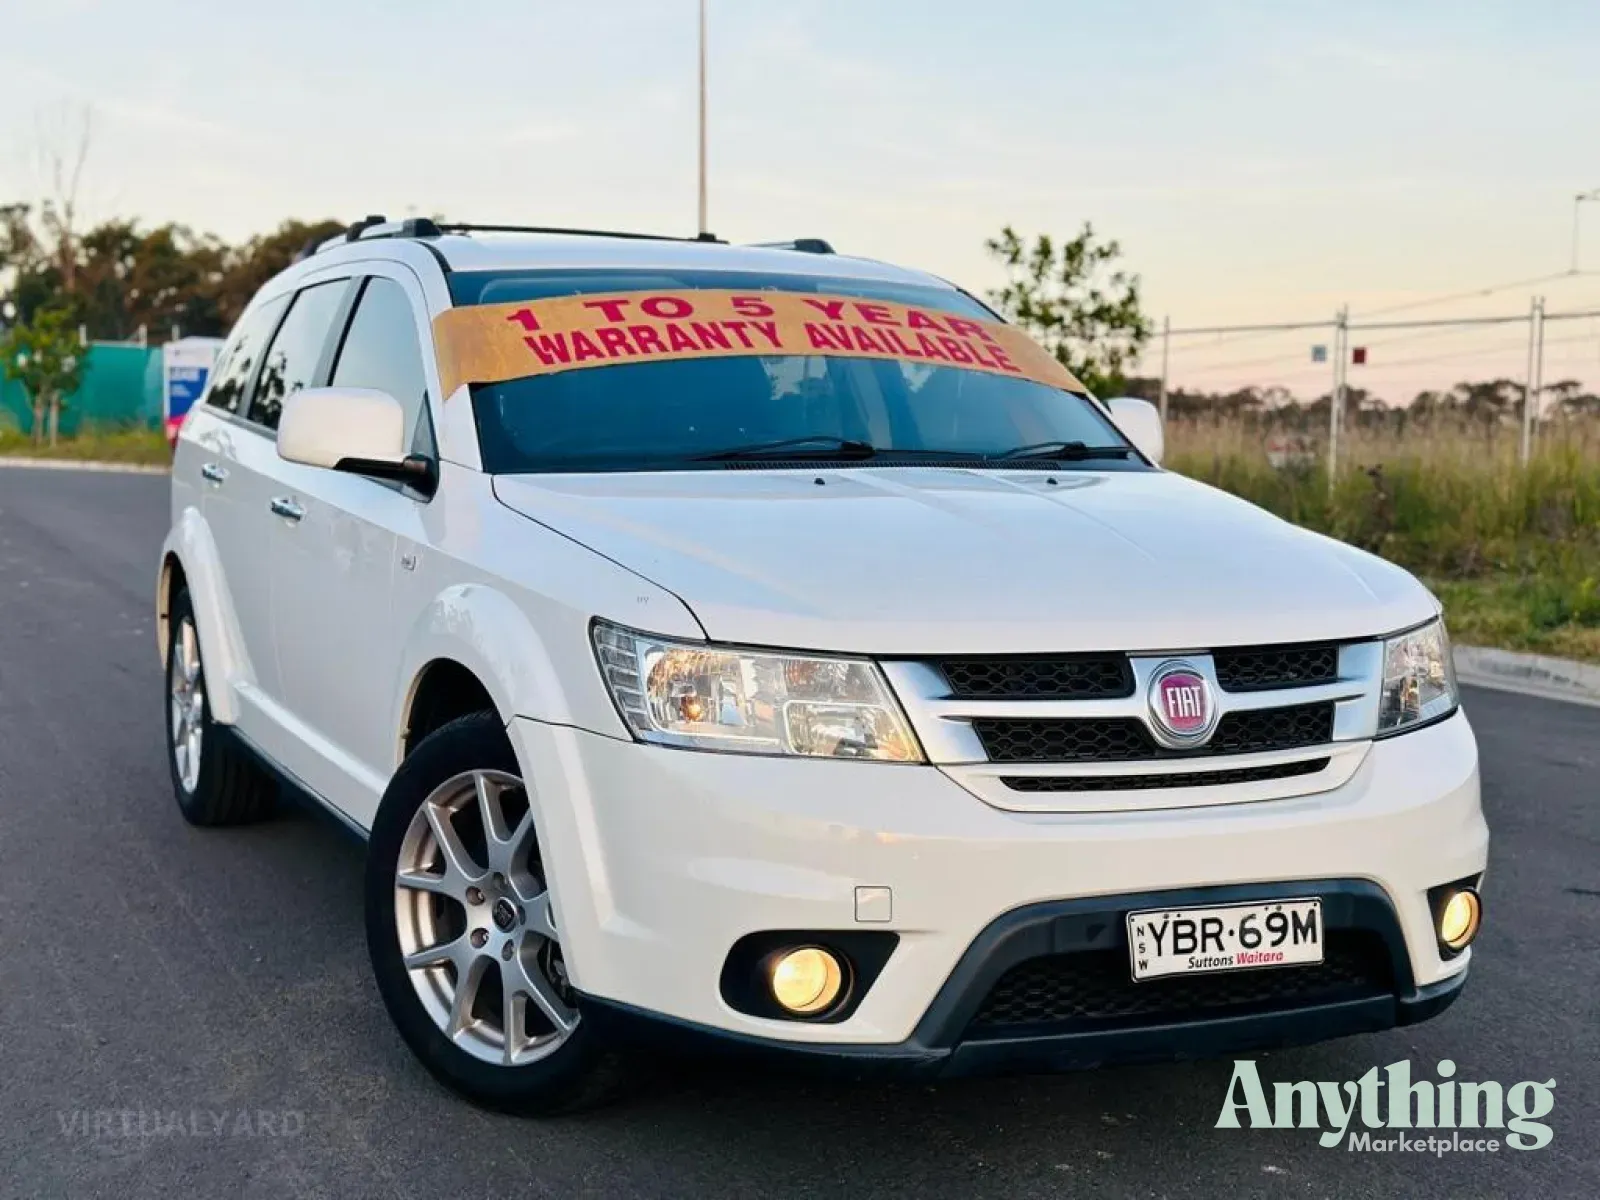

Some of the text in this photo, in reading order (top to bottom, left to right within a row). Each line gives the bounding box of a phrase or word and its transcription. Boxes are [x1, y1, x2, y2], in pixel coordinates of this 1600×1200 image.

[507, 296, 995, 342] 1 TO 5 YEAR
[524, 321, 1022, 373] WARRANTY AVAILABLE
[1165, 686, 1201, 718] FIAT
[1188, 950, 1284, 969] Suttons Waitara
